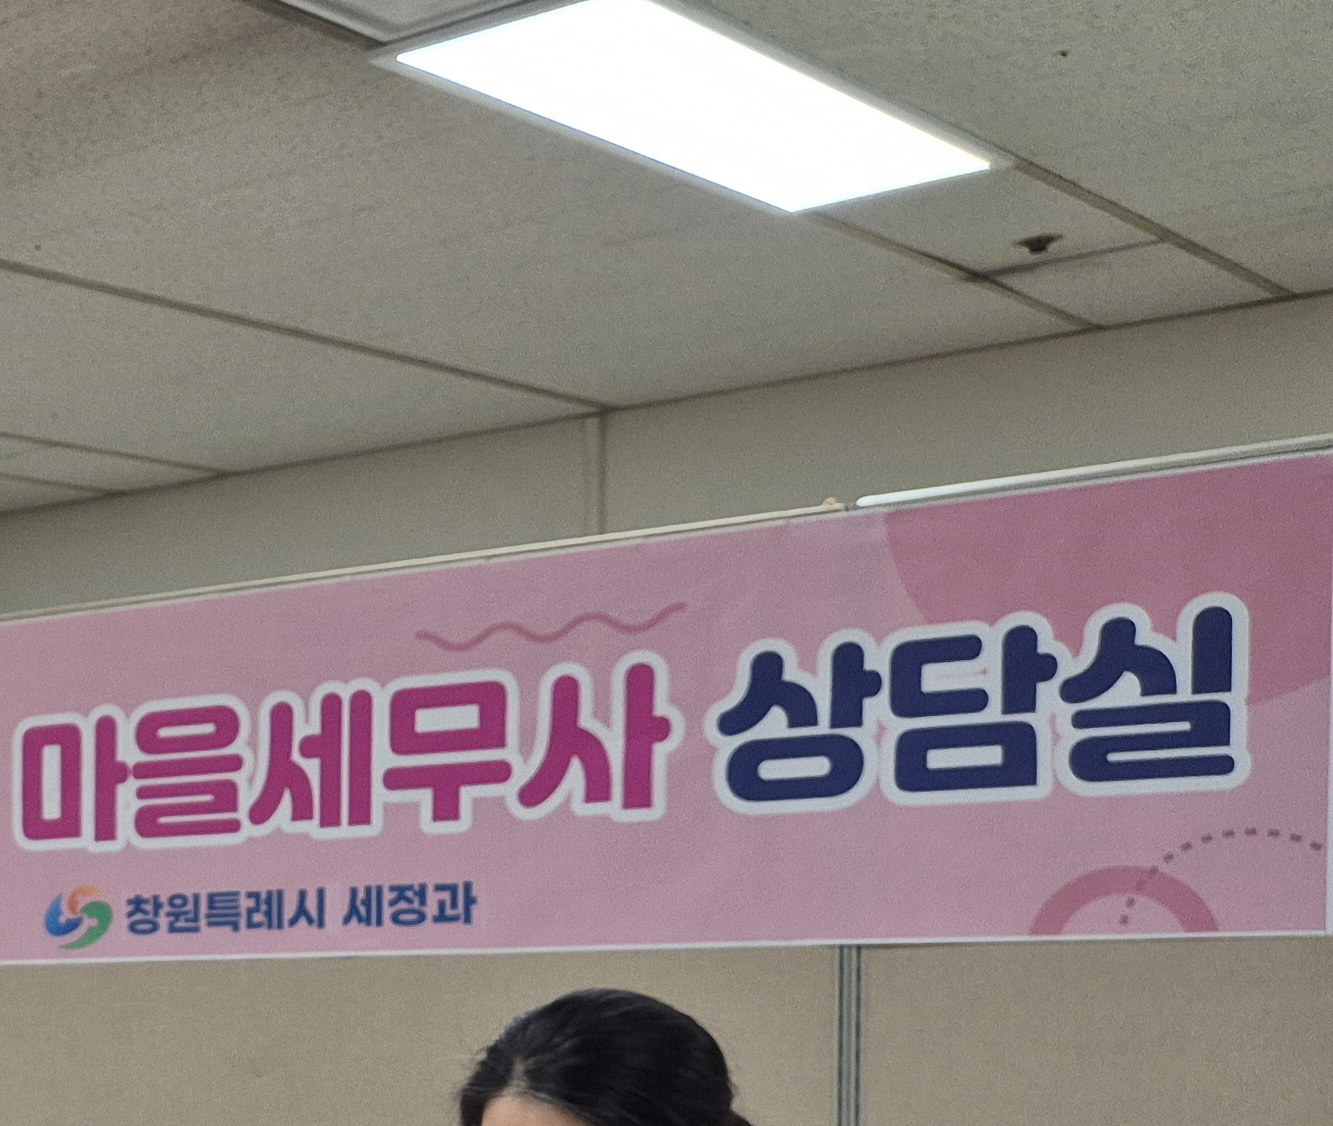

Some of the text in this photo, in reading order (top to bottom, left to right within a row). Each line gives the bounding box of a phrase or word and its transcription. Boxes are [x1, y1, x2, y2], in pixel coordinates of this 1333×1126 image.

[20, 660, 672, 843] 마을세무사
[716, 604, 1236, 804] 상담실
[125, 881, 477, 936] 창원특례시 세정과
